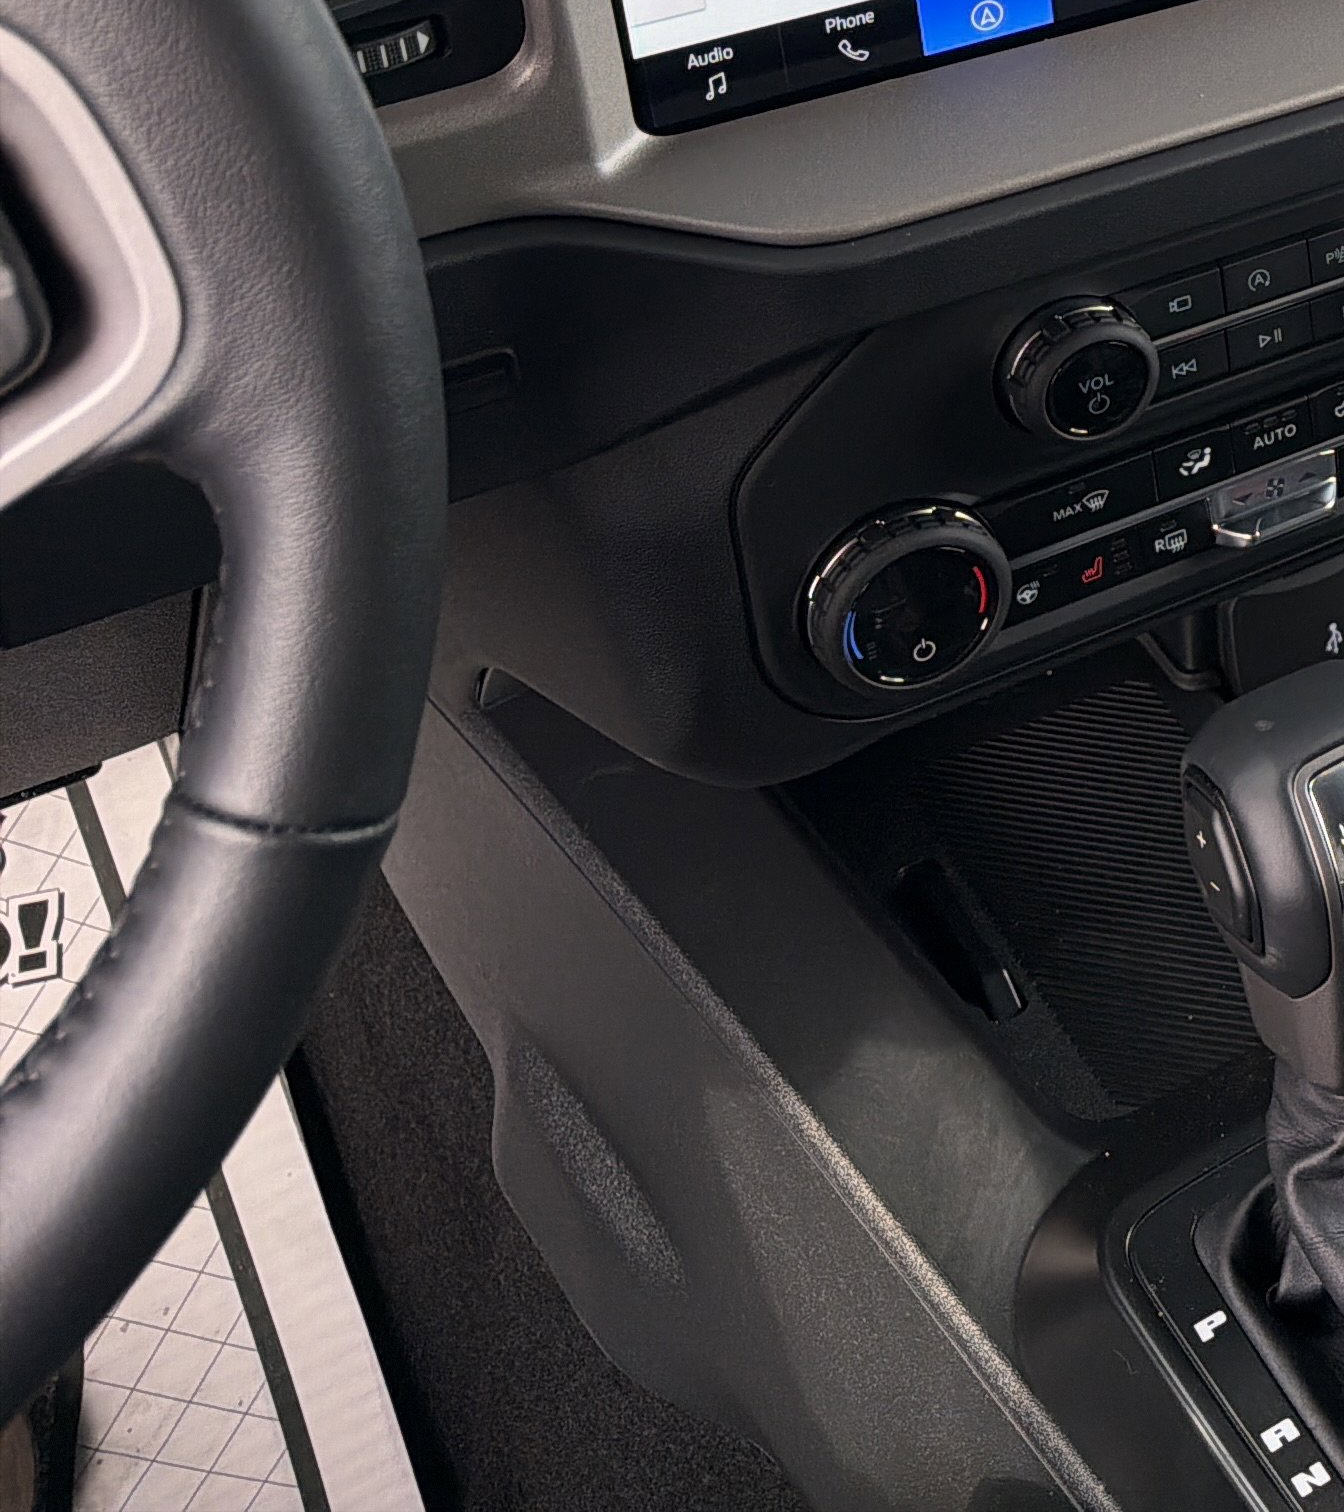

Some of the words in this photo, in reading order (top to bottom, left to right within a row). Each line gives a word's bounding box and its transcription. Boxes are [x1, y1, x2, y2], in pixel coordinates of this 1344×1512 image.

[824, 8, 875, 35] Phone
[687, 45, 734, 70] Audio
[1078, 372, 1114, 394] VOL
[1253, 423, 1297, 450] AUTO
[1052, 501, 1084, 522] MAX
[1193, 1310, 1228, 1343] P
[1259, 1418, 1301, 1454] R
[1290, 1461, 1331, 1498] N
